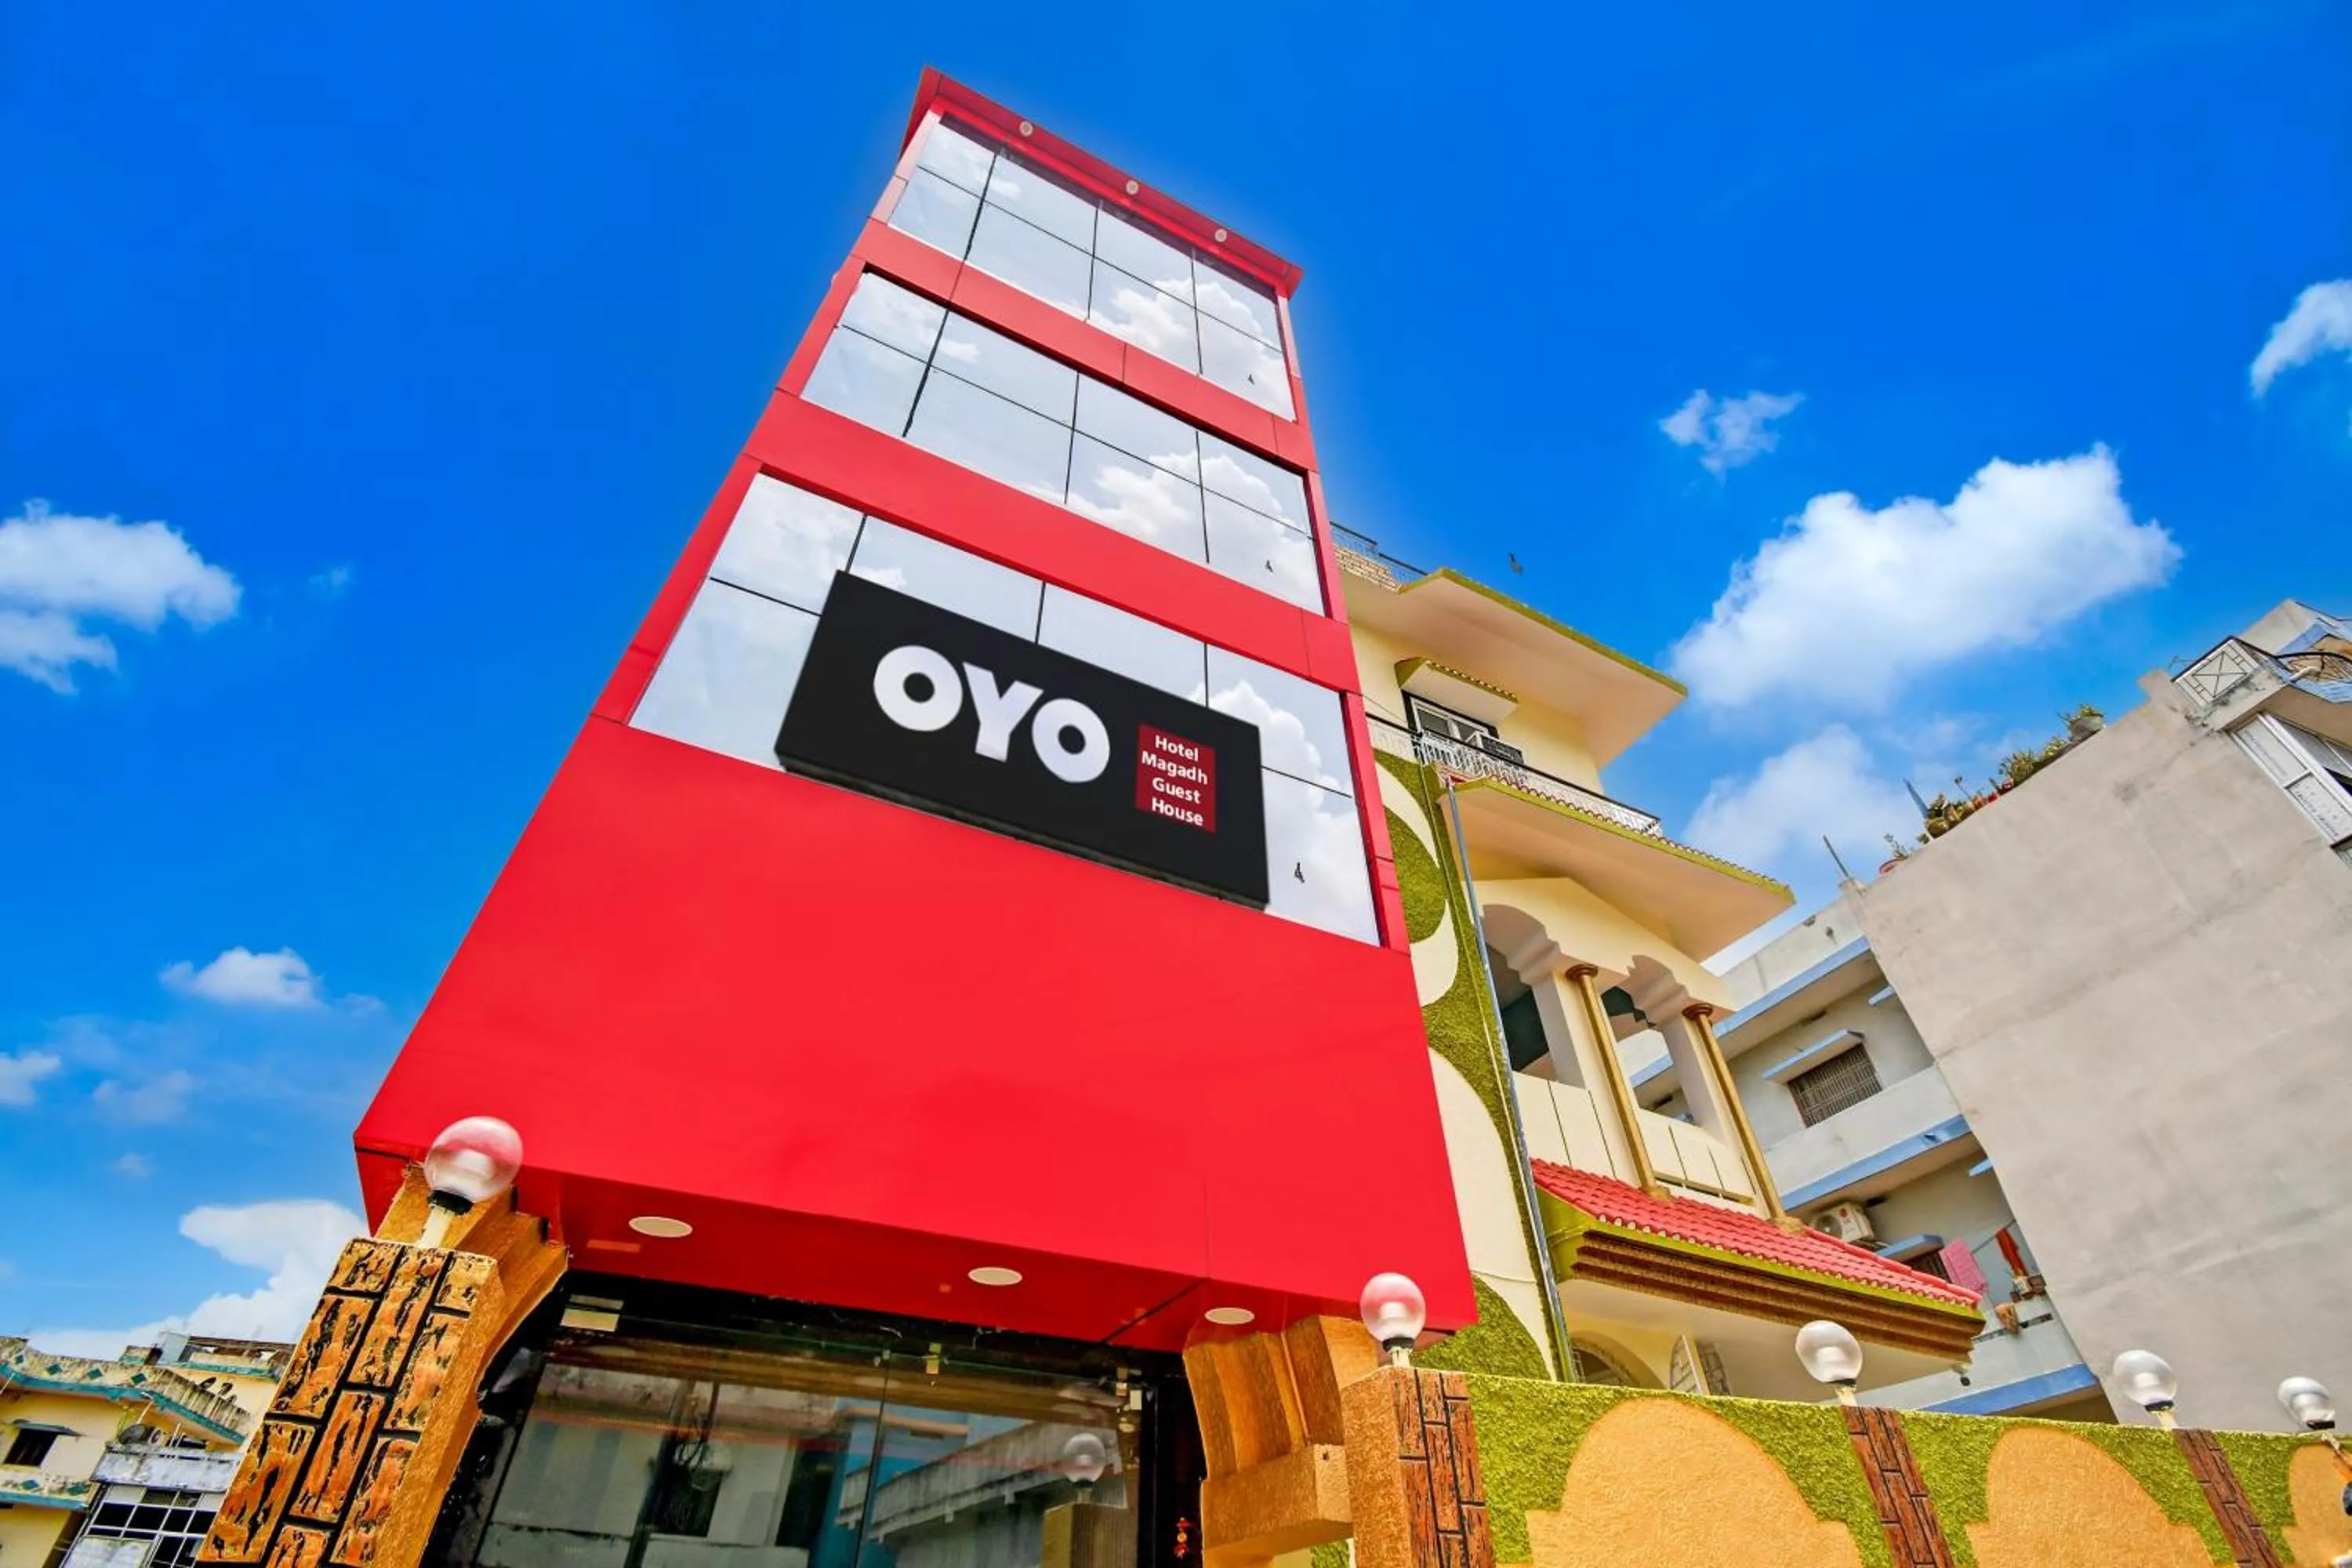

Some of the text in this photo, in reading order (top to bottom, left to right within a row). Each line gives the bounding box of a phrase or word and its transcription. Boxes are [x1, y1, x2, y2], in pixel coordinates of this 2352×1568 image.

[873, 645, 1110, 782] OYO
[1155, 735, 1199, 761] Hotel
[1142, 750, 1208, 785] Magadh
[1152, 777, 1201, 804] Guest
[1151, 797, 1203, 826] House
